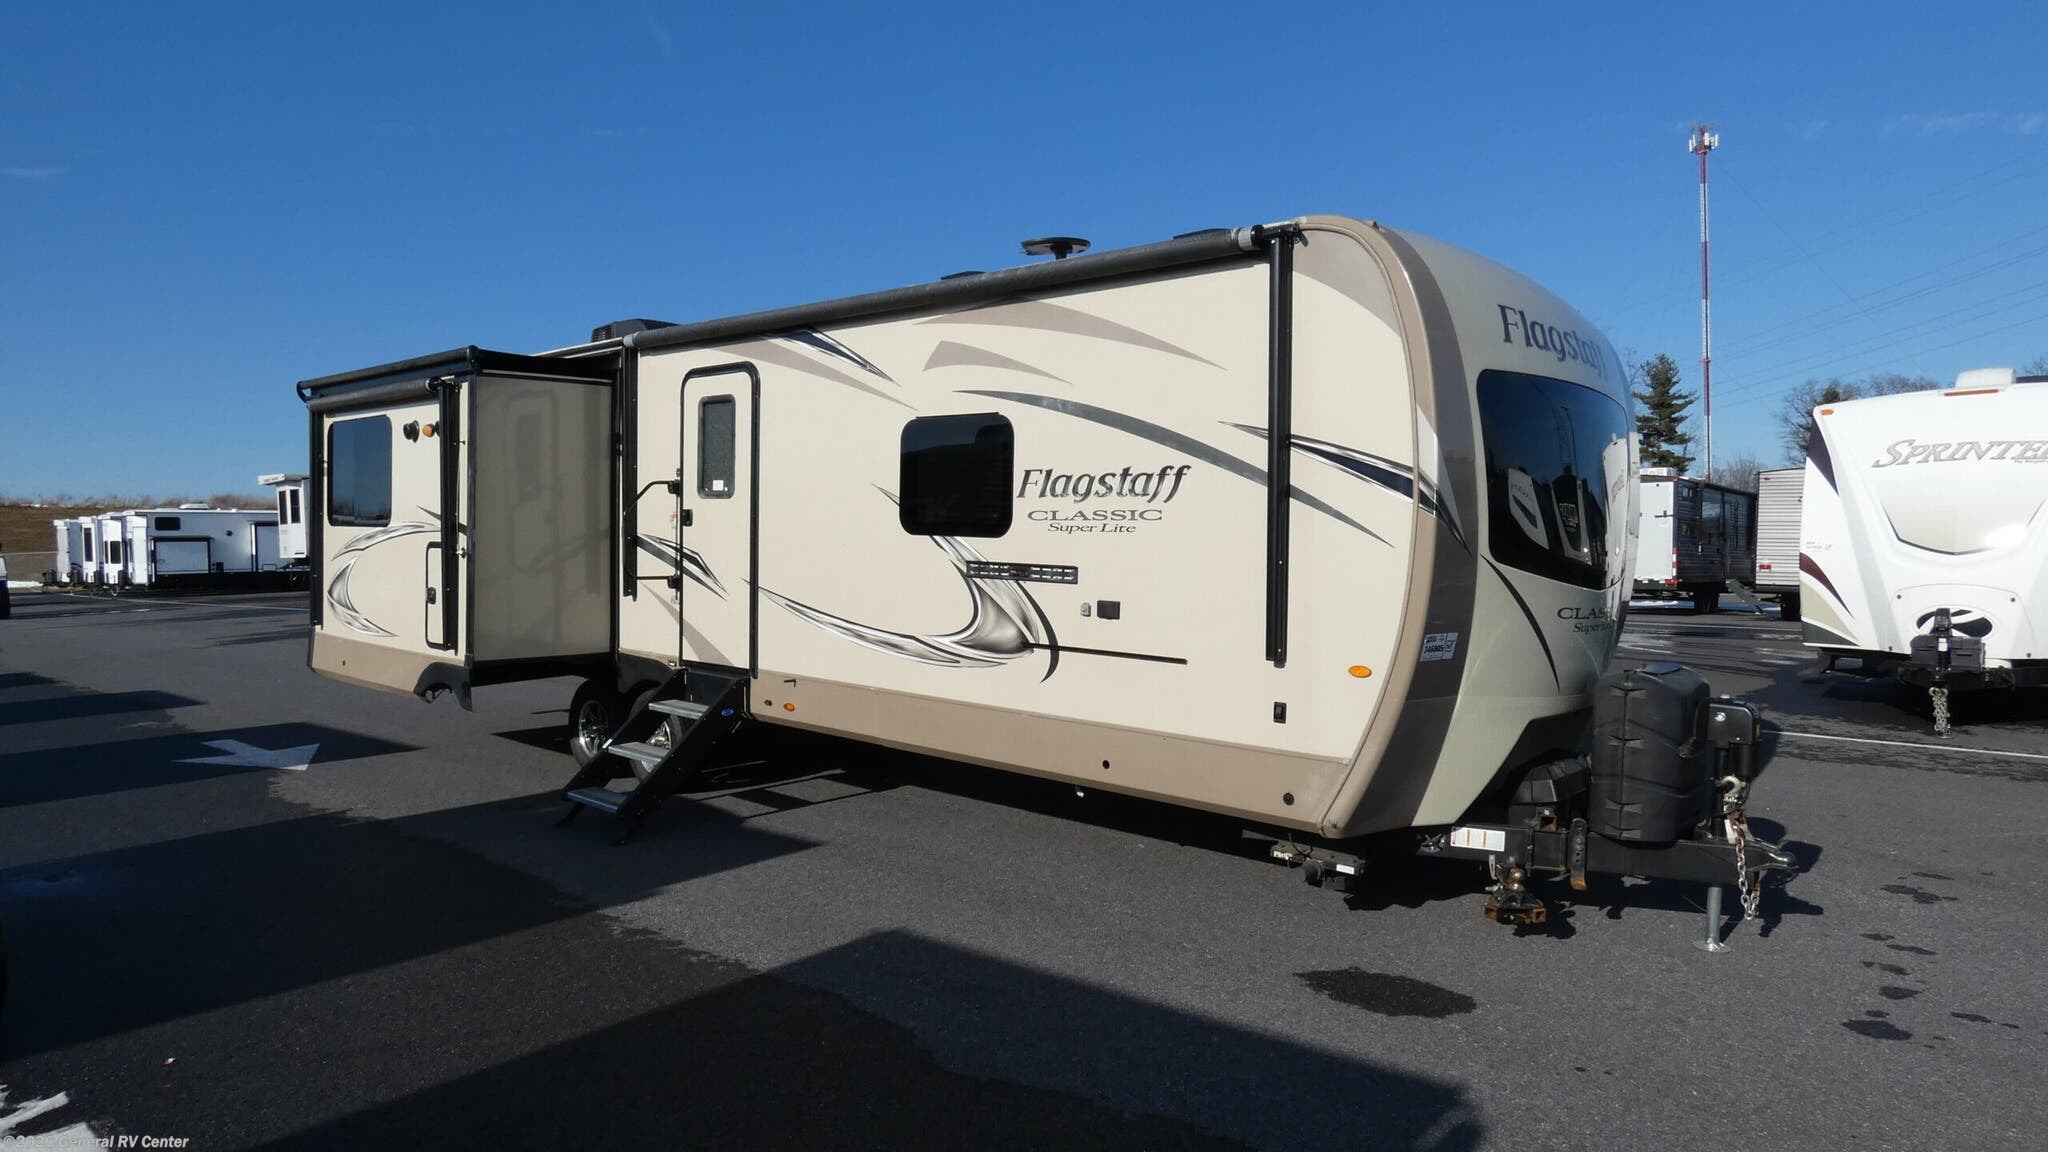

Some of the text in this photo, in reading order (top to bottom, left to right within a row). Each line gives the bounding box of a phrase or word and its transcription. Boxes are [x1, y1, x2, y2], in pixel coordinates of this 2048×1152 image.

[1016, 465, 1192, 504] Flagstaff
[1027, 509, 1163, 521] CLASSIC
[1047, 522, 1137, 535] Super Lite
